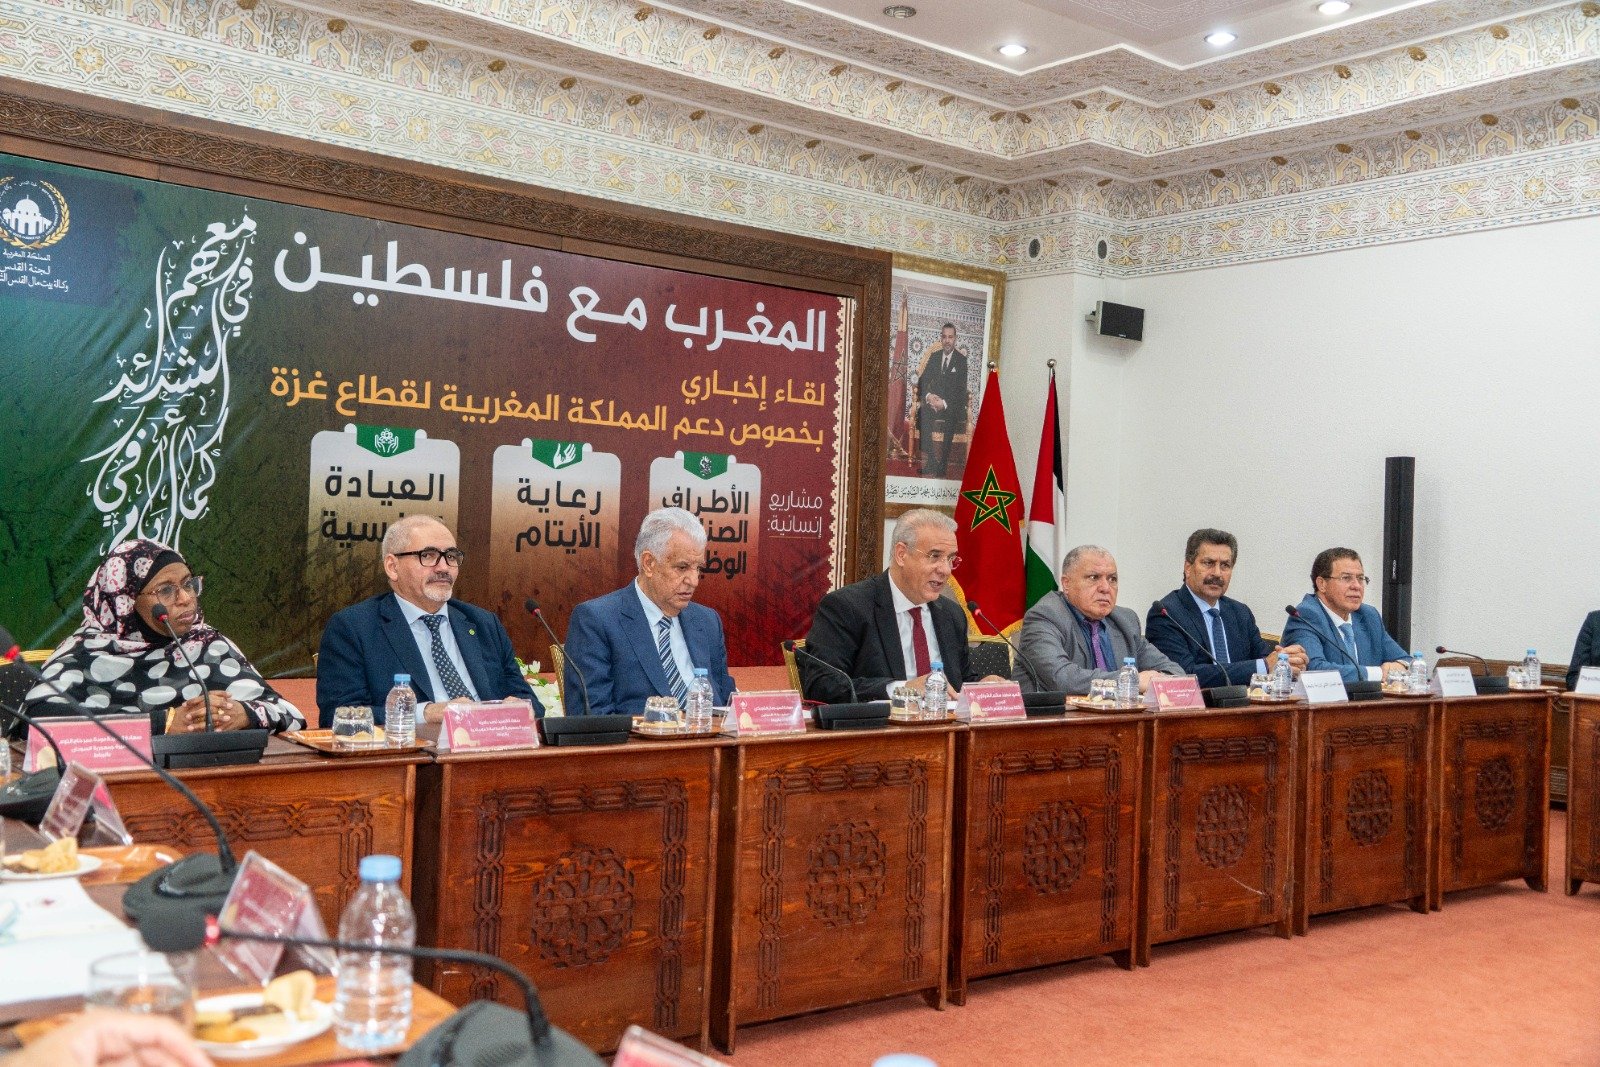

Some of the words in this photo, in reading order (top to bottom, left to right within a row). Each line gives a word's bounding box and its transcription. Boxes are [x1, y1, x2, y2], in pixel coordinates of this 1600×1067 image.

[28, 263, 51, 275] لجنة
[274, 231, 549, 313] فلسطين
[566, 286, 648, 343] مع
[665, 301, 826, 353] المغرب
[270, 366, 328, 407] غزة
[335, 373, 431, 417] لقطاع
[439, 384, 559, 424] المغربية
[681, 370, 767, 411] إخباري
[774, 378, 825, 406] لقاء
[567, 397, 667, 431] المملكة
[673, 415, 724, 440] دعم
[729, 420, 824, 453] بخصوص
[325, 466, 445, 506] العيادة
[517, 478, 601, 515] رعاية
[662, 484, 749, 516] الأطراف
[768, 488, 823, 511] مشاريع
[515, 514, 600, 554] الأيتام
[767, 514, 822, 538] إنسانية:
